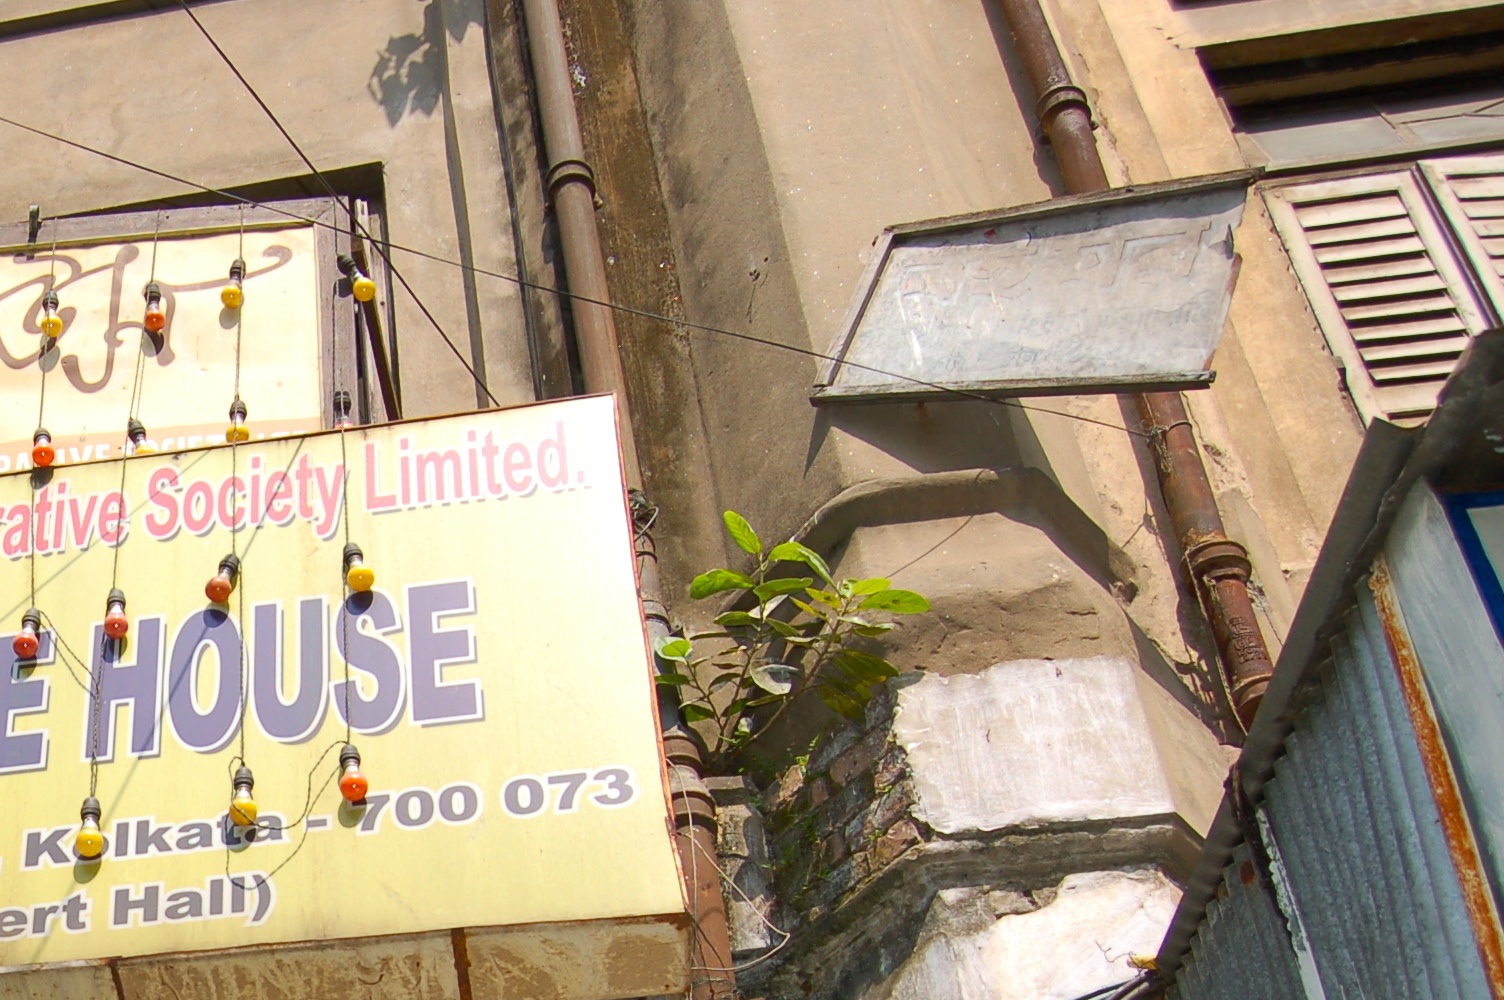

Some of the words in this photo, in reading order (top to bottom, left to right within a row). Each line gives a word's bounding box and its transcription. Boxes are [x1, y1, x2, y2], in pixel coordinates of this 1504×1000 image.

[146, 456, 344, 537] Society
[365, 420, 586, 509] Limited.
[86, 581, 483, 757] HOUSE
[363, 783, 478, 831] 700
[506, 769, 634, 815] 073
[113, 875, 276, 926] Hall)
